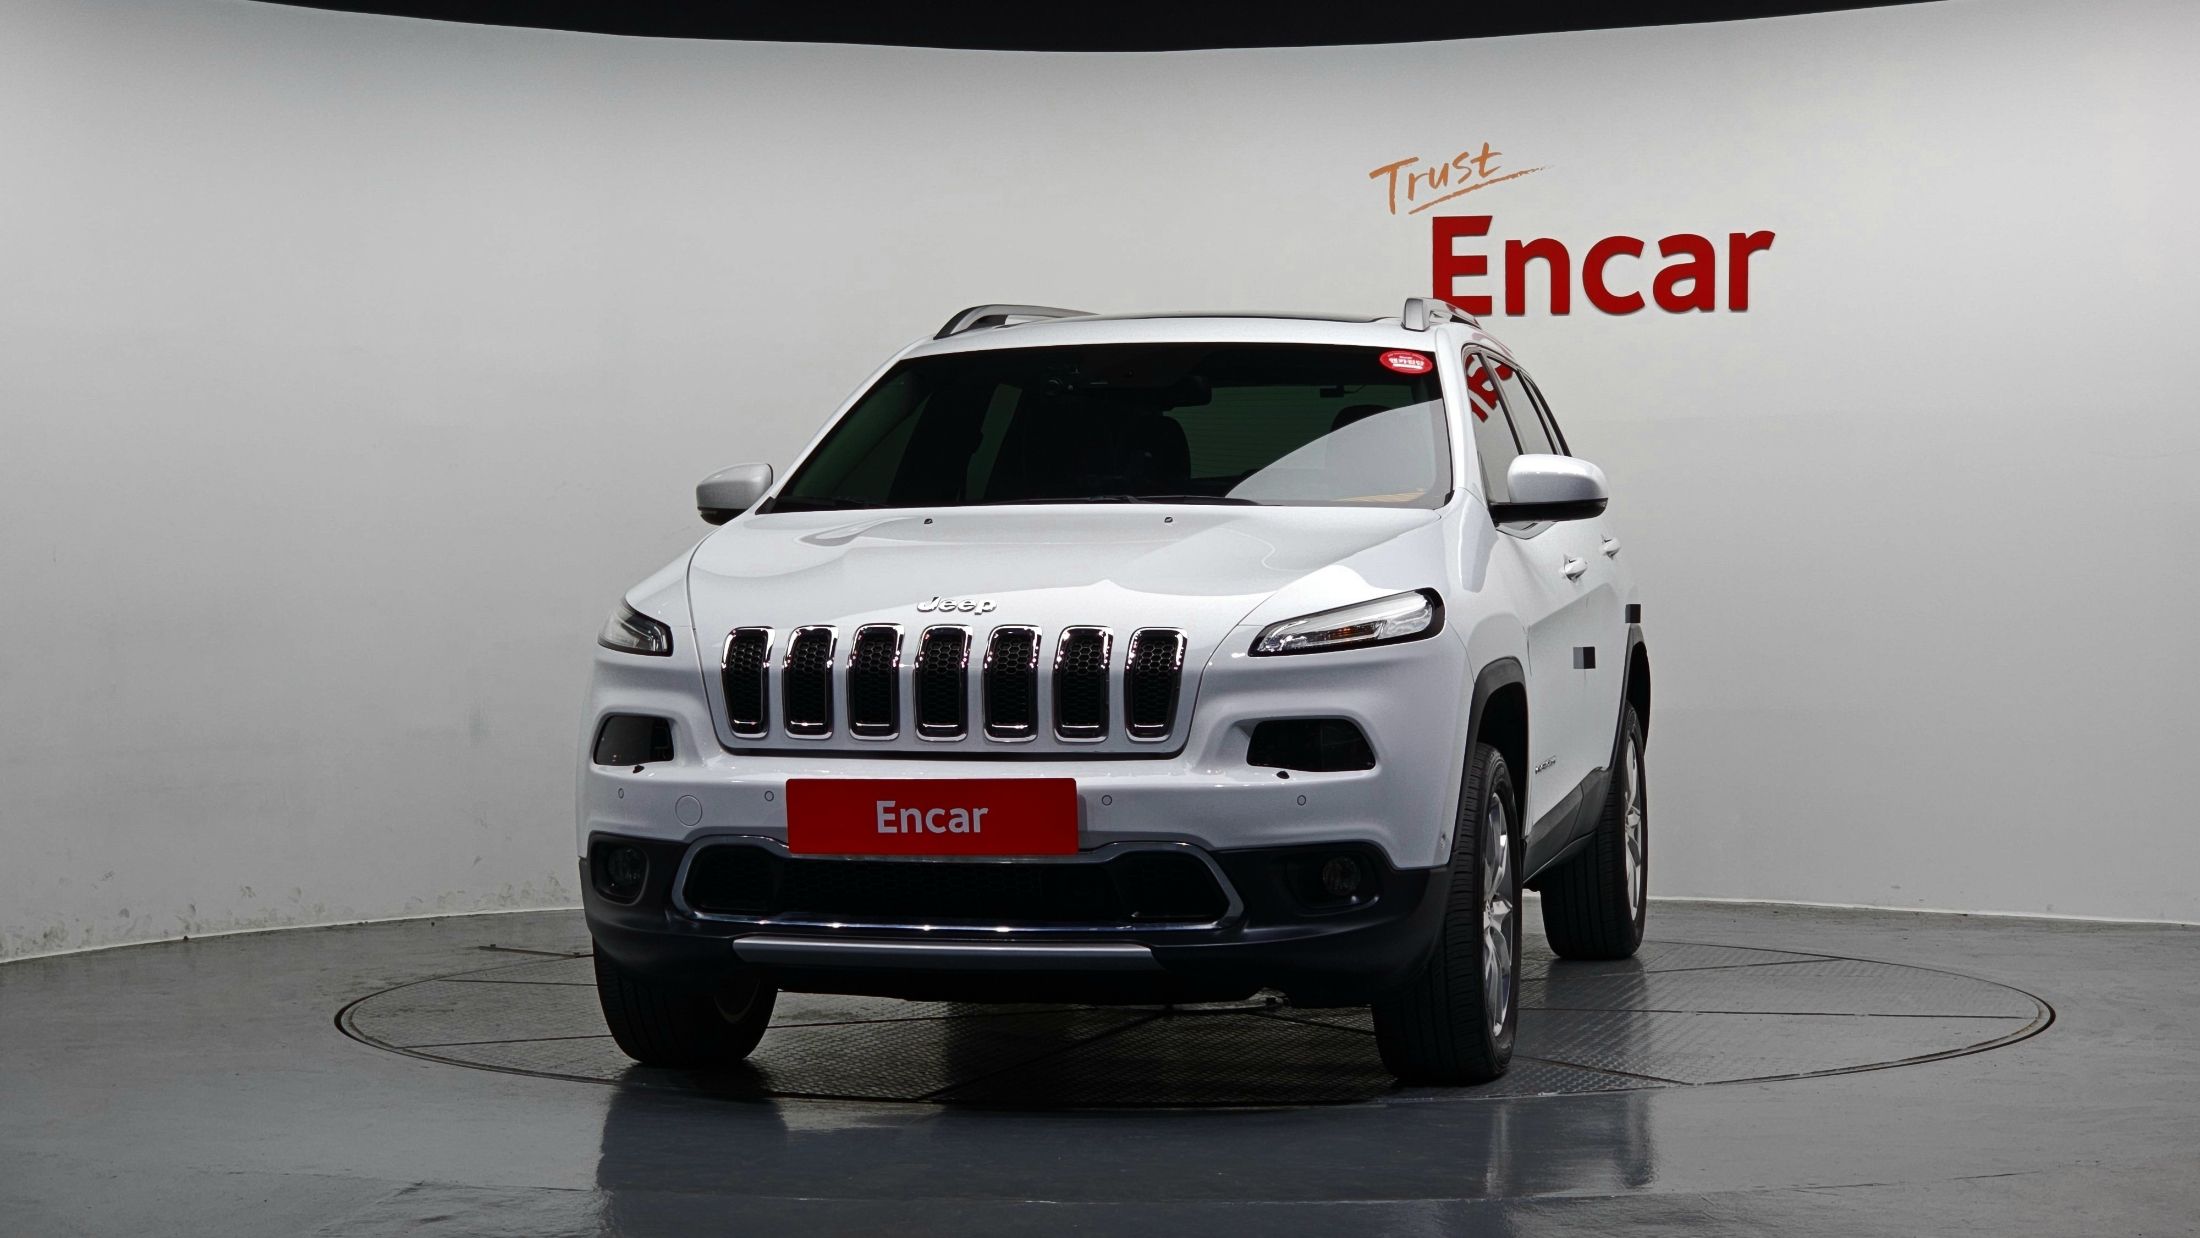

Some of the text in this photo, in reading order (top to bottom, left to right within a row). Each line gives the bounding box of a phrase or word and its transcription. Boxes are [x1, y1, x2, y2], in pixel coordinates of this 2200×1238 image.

[1369, 142, 1502, 215] Trust
[1432, 215, 1776, 315] Encar
[917, 596, 997, 615] Jeep
[876, 800, 989, 834] Encar
